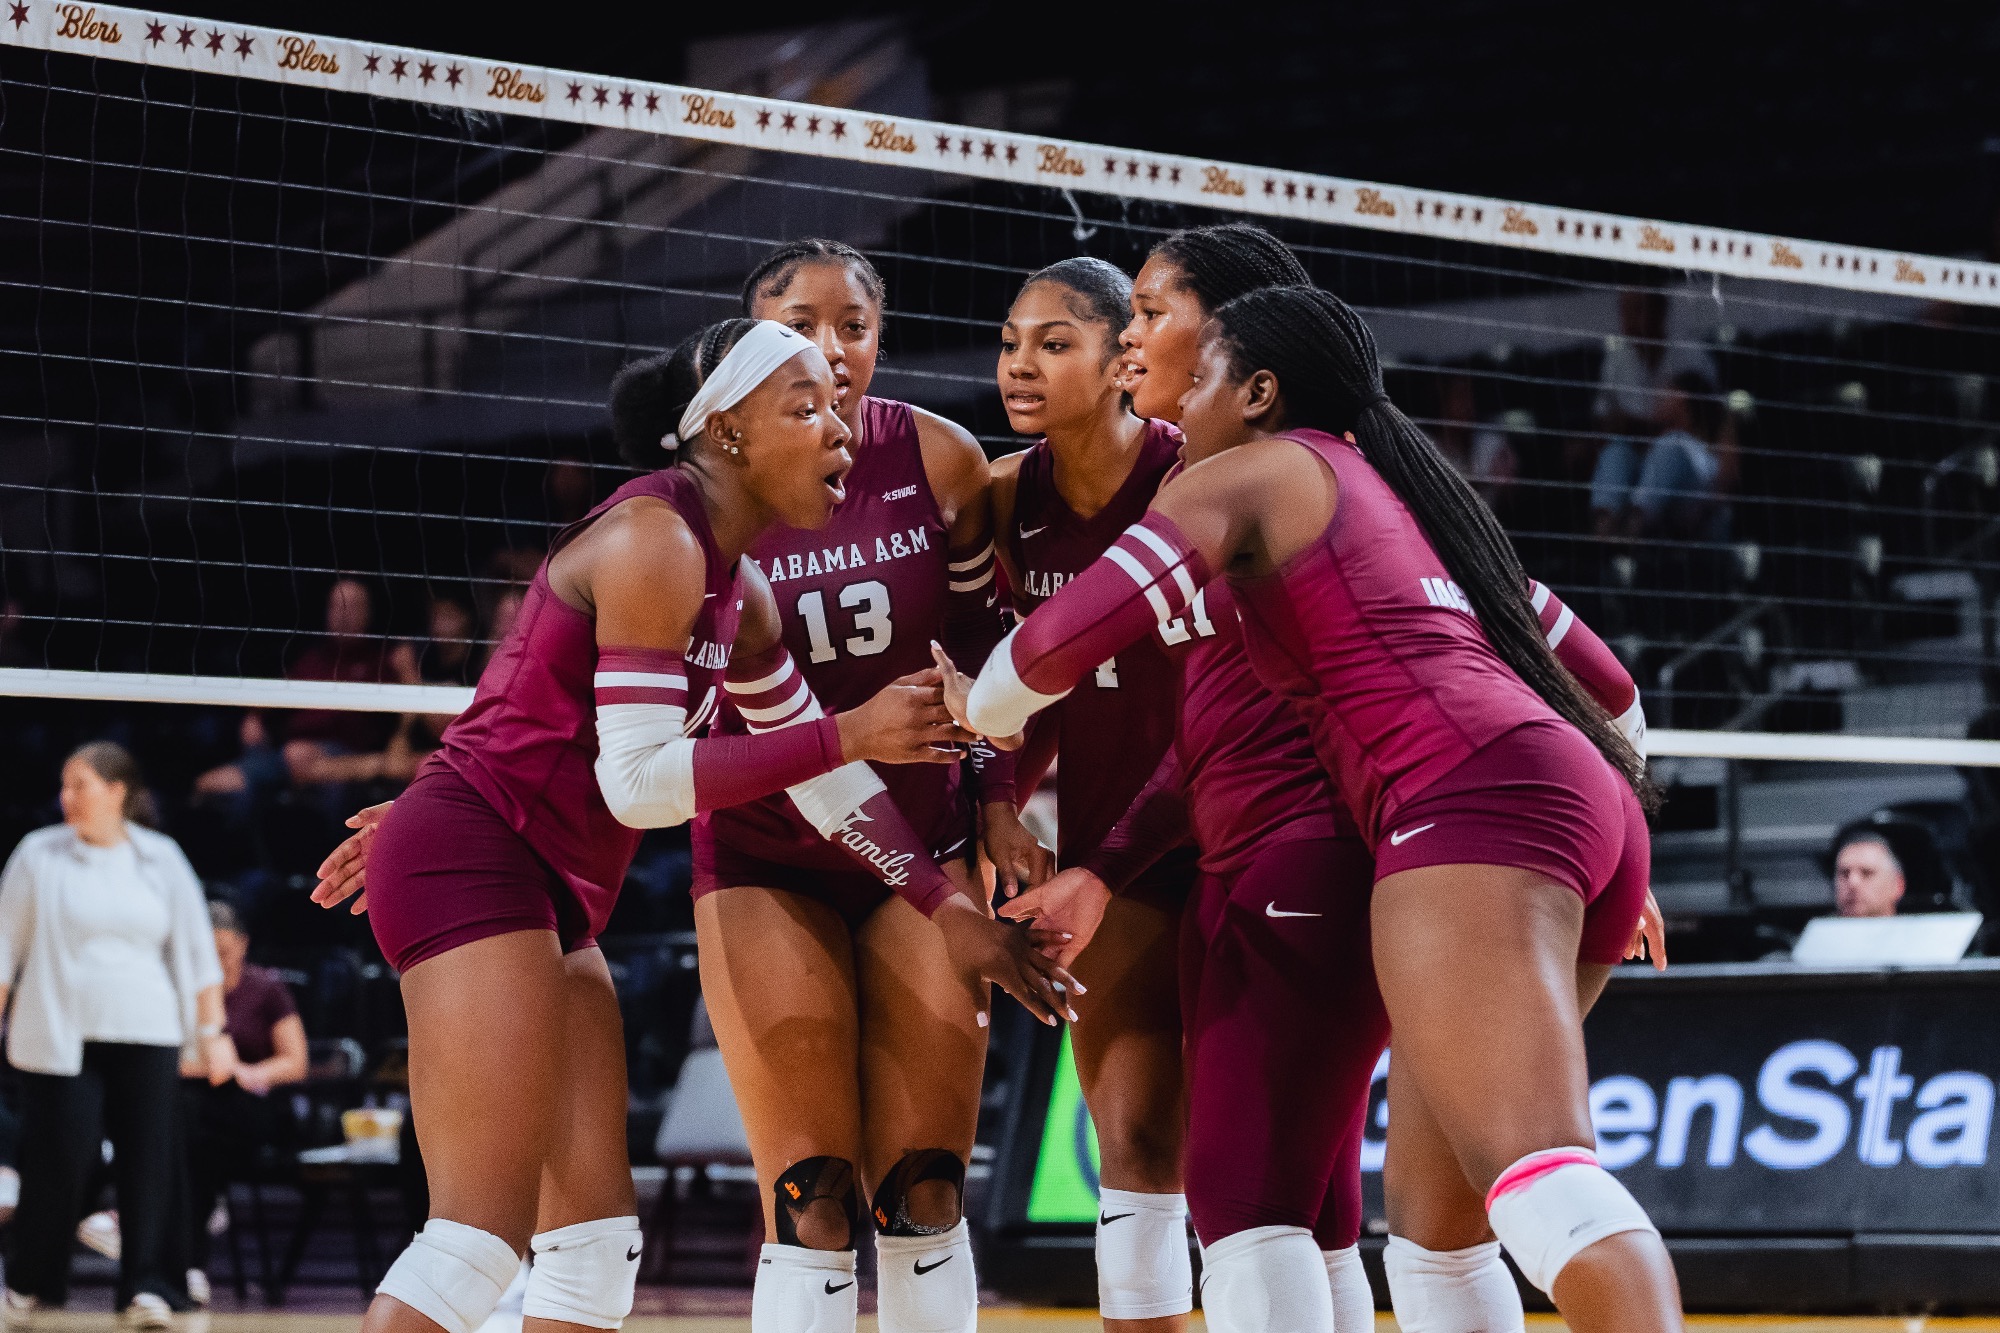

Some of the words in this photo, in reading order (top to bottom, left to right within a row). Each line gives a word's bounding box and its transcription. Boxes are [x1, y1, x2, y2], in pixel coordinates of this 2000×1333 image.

[55, 4, 123, 45] 'Blers
[277, 36, 341, 75] 'Blers
[486, 67, 546, 104] 'Blers
[681, 95, 737, 130] 'Blers
[891, 484, 917, 501] SWAC
[754, 543, 866, 583] ABAMA
[874, 525, 930, 563] A&M
[1419, 577, 1475, 617] JAC
[797, 580, 892, 664] 13
[839, 807, 915, 886] Family
